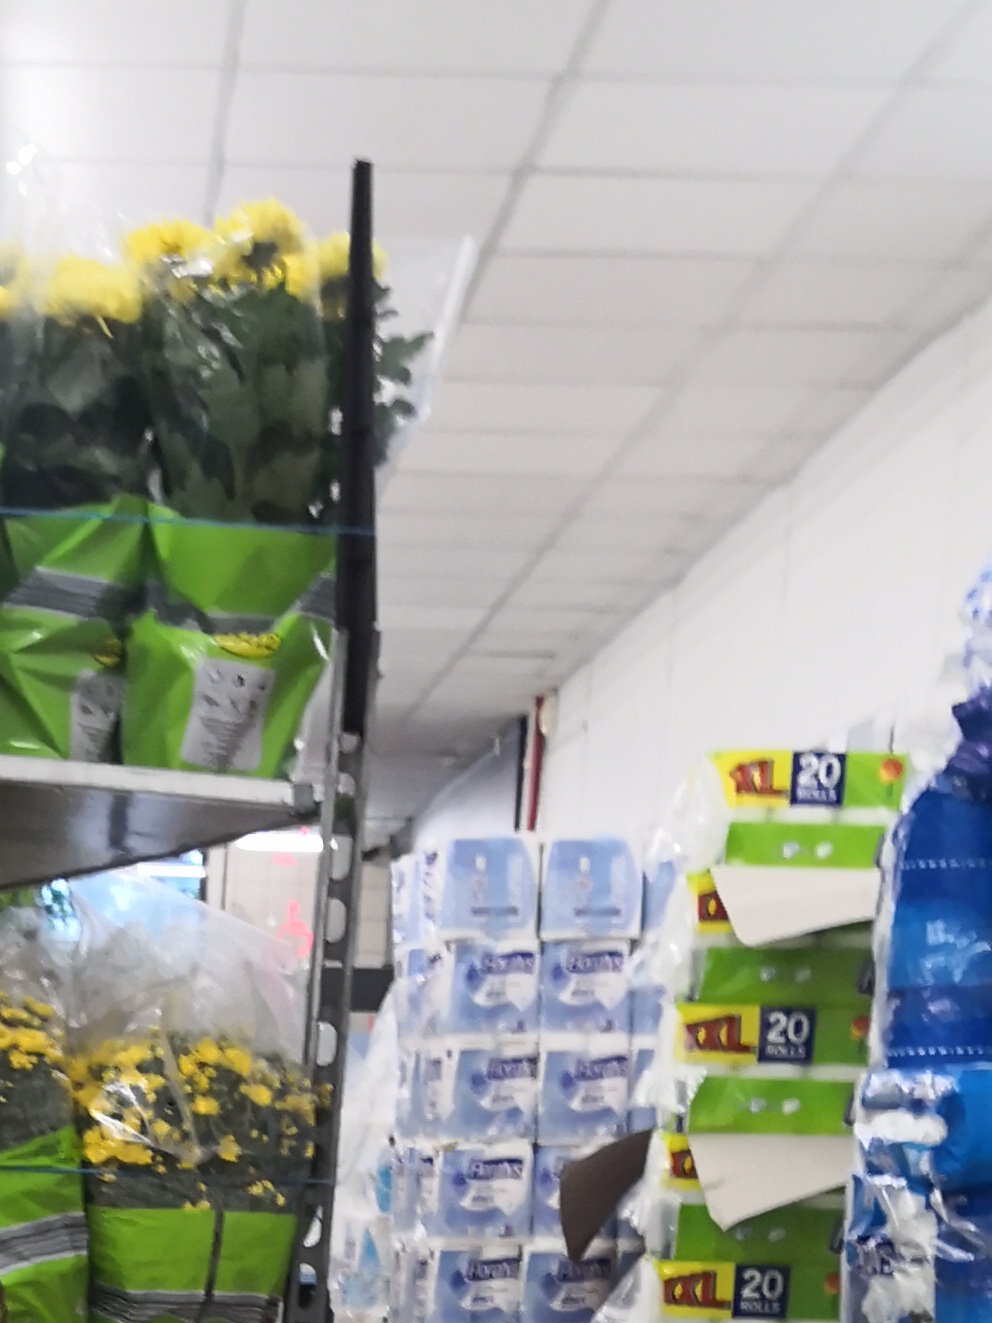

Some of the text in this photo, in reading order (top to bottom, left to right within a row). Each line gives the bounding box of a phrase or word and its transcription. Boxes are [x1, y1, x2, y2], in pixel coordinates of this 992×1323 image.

[797, 752, 841, 788] 20
[766, 1011, 809, 1044] 20
[663, 1271, 732, 1311] XXL
[740, 1267, 784, 1301] 20
